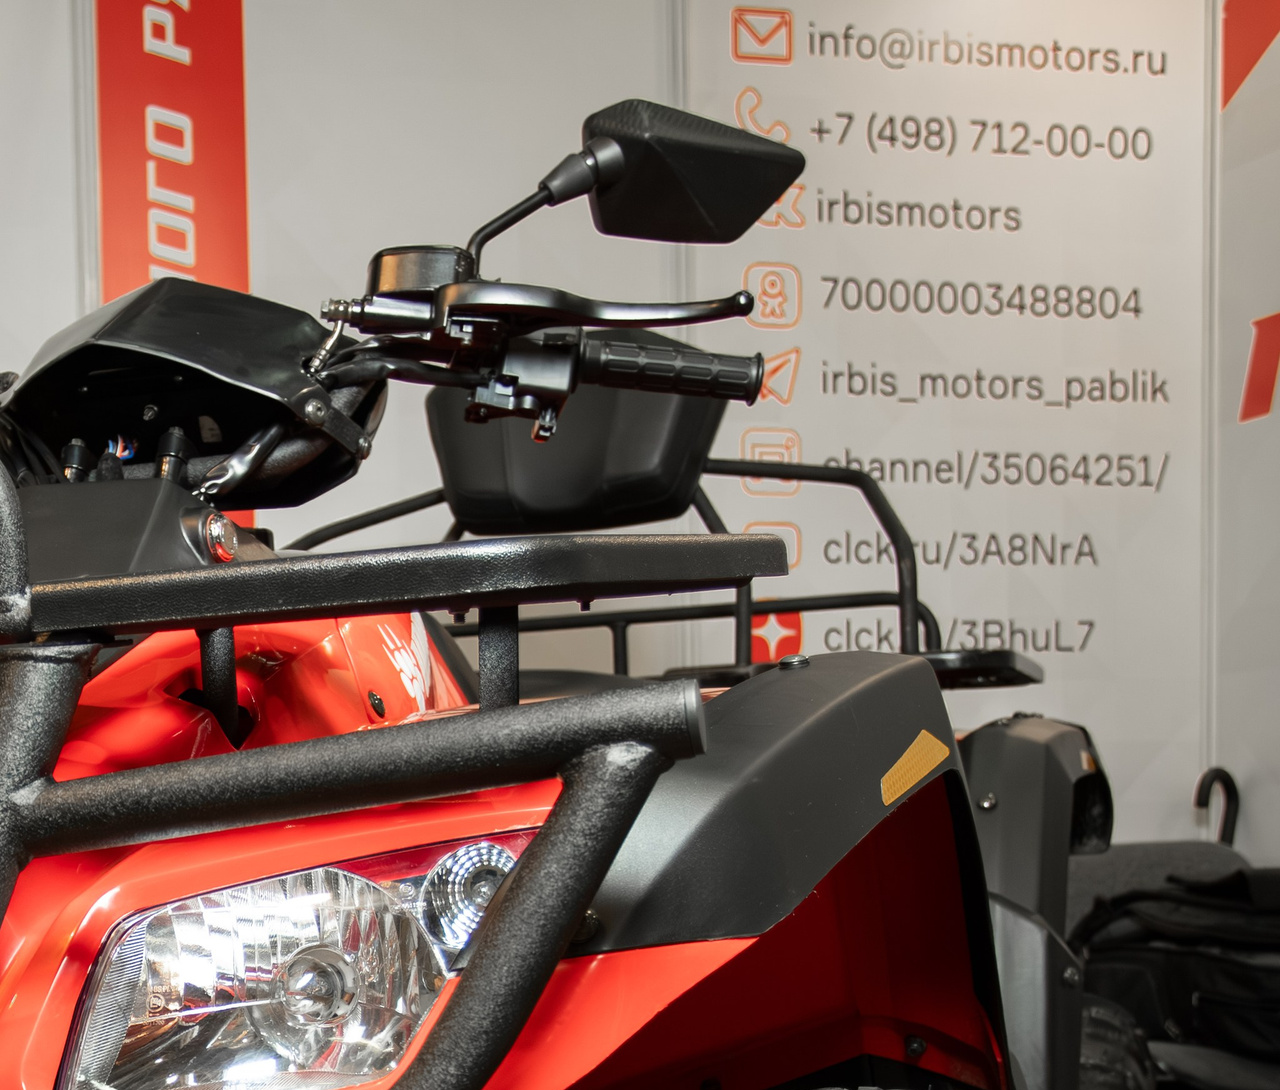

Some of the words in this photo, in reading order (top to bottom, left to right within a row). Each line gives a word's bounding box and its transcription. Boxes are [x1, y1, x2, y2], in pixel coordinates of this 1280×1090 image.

[142, 0, 192, 66] Р
[807, 20, 1168, 76] info@irbismotors.ru
[809, 111, 855, 147] +7
[866, 111, 959, 157] (498)
[969, 118, 1154, 161] 712-00-00
[145, 104, 197, 282] ОГО
[815, 187, 1023, 233] irbismotors
[820, 275, 1144, 320] 70000003488804
[821, 360, 1170, 409] irbis_motors_pablik
